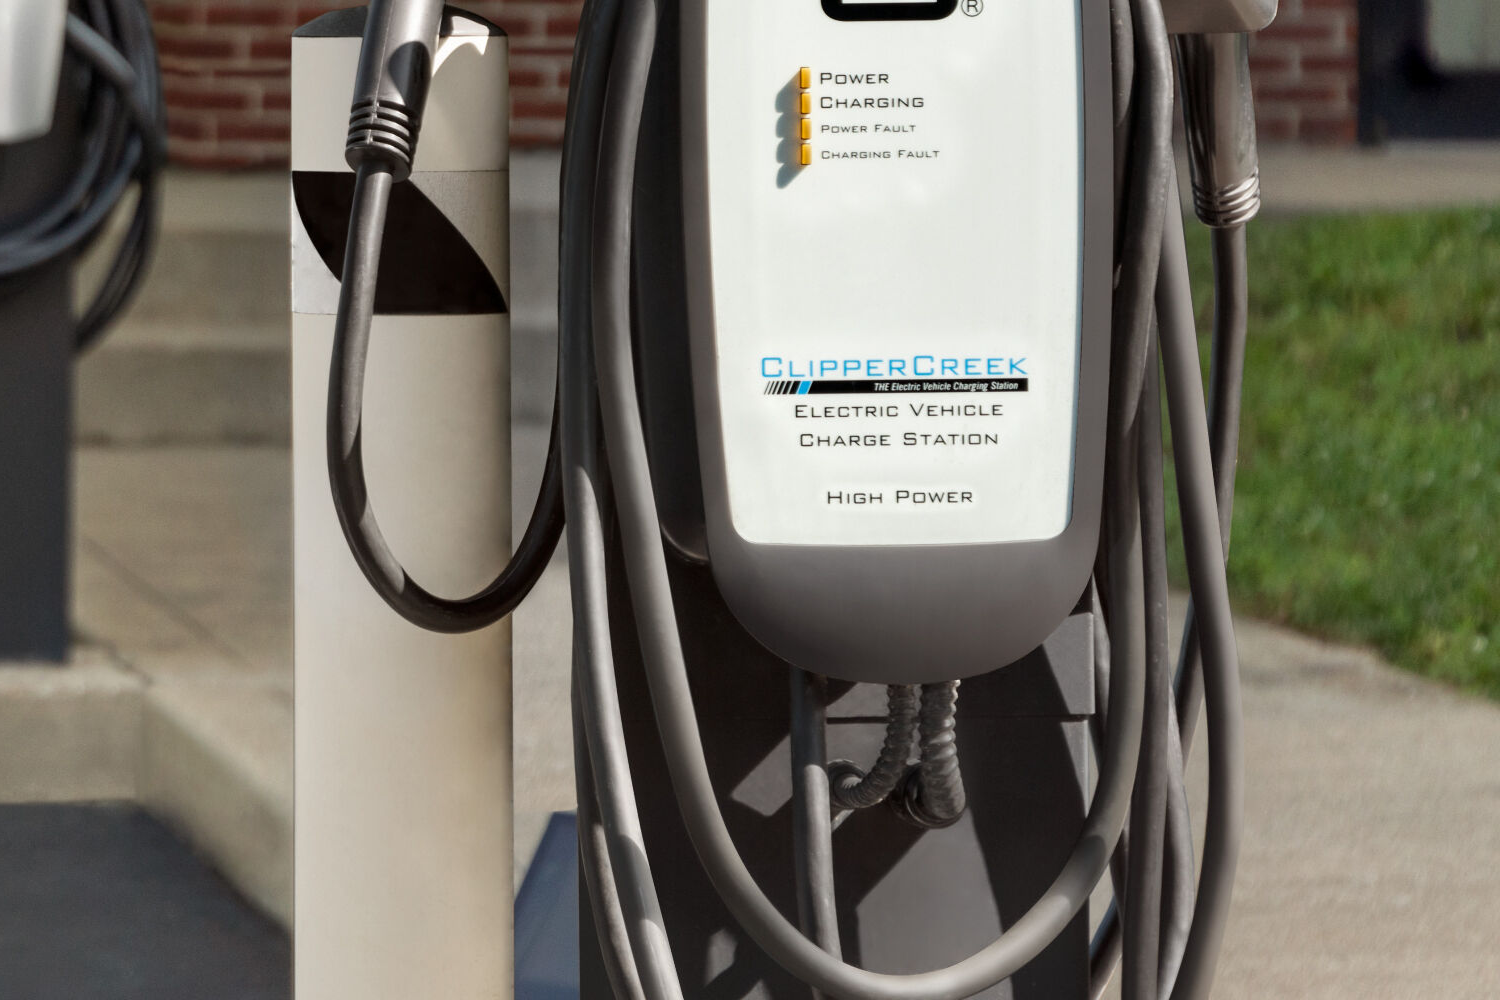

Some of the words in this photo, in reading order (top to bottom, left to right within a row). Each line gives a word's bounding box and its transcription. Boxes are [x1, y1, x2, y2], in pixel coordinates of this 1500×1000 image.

[819, 72, 890, 86] POWER
[819, 96, 925, 110] CHARGING
[820, 123, 868, 134] POWER
[874, 122, 917, 134] FAULT
[820, 149, 892, 161] CHARGING
[897, 149, 941, 160] FAULT
[761, 355, 1028, 378] CLIPPERCREEK
[874, 382, 890, 391] THE
[891, 382, 921, 391] Electric
[922, 381, 951, 391] Vehicle
[953, 381, 988, 392] Charging
[991, 381, 1019, 390] Station
[794, 404, 899, 418] ELECTRIC
[909, 403, 1004, 417] VEHICLE
[799, 433, 892, 447] CHARGE
[902, 431, 999, 446] STATION
[827, 490, 883, 504] HIGH
[895, 489, 973, 504] POWER
